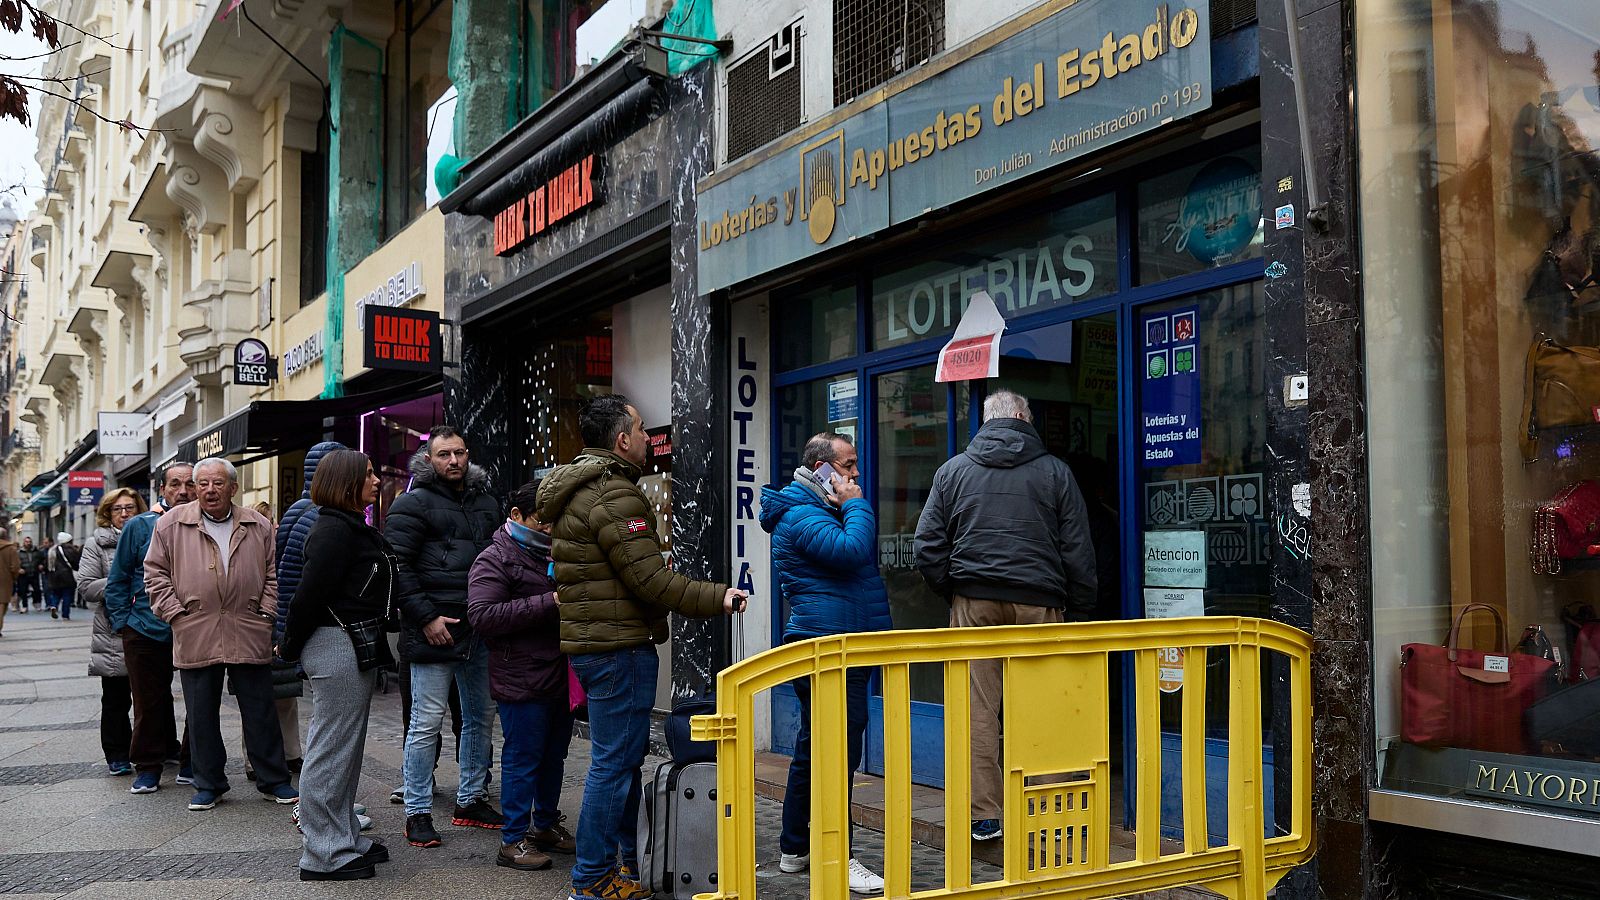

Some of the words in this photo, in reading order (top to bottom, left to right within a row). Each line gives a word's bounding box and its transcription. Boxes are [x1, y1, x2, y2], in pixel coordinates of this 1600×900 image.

[700, 194, 778, 252] Loterías
[783, 186, 797, 226] y
[849, 103, 981, 190] Apuestas
[991, 60, 1045, 127] del
[1057, 5, 1199, 99] Estado
[974, 165, 998, 185] Don
[999, 150, 1032, 177] Julián
[1049, 105, 1148, 157] Administración
[1173, 82, 1202, 109] 193
[493, 196, 526, 257] WOK
[527, 184, 546, 237] TO
[548, 153, 594, 226] WALK
[386, 261, 424, 308] BELL
[886, 234, 1095, 342] LOTERIAS
[374, 315, 431, 347] WOK
[284, 343, 303, 378] TACO
[303, 330, 323, 366] BELL
[374, 342, 391, 359] TO
[393, 345, 431, 363] WALK
[950, 349, 981, 366] 48020
[237, 364, 268, 374] TACO
[239, 373, 267, 383] BELL
[1145, 414, 1179, 427] Loterías
[1180, 414, 1187, 426] y
[197, 435, 211, 461] TACO
[209, 431, 223, 456] BELL
[1145, 430, 1183, 445] Apuestas
[1185, 427, 1199, 439] del
[733, 336, 757, 596] LOTERIA
[1145, 447, 1174, 460] Estado
[1147, 547, 1199, 561] Atencion
